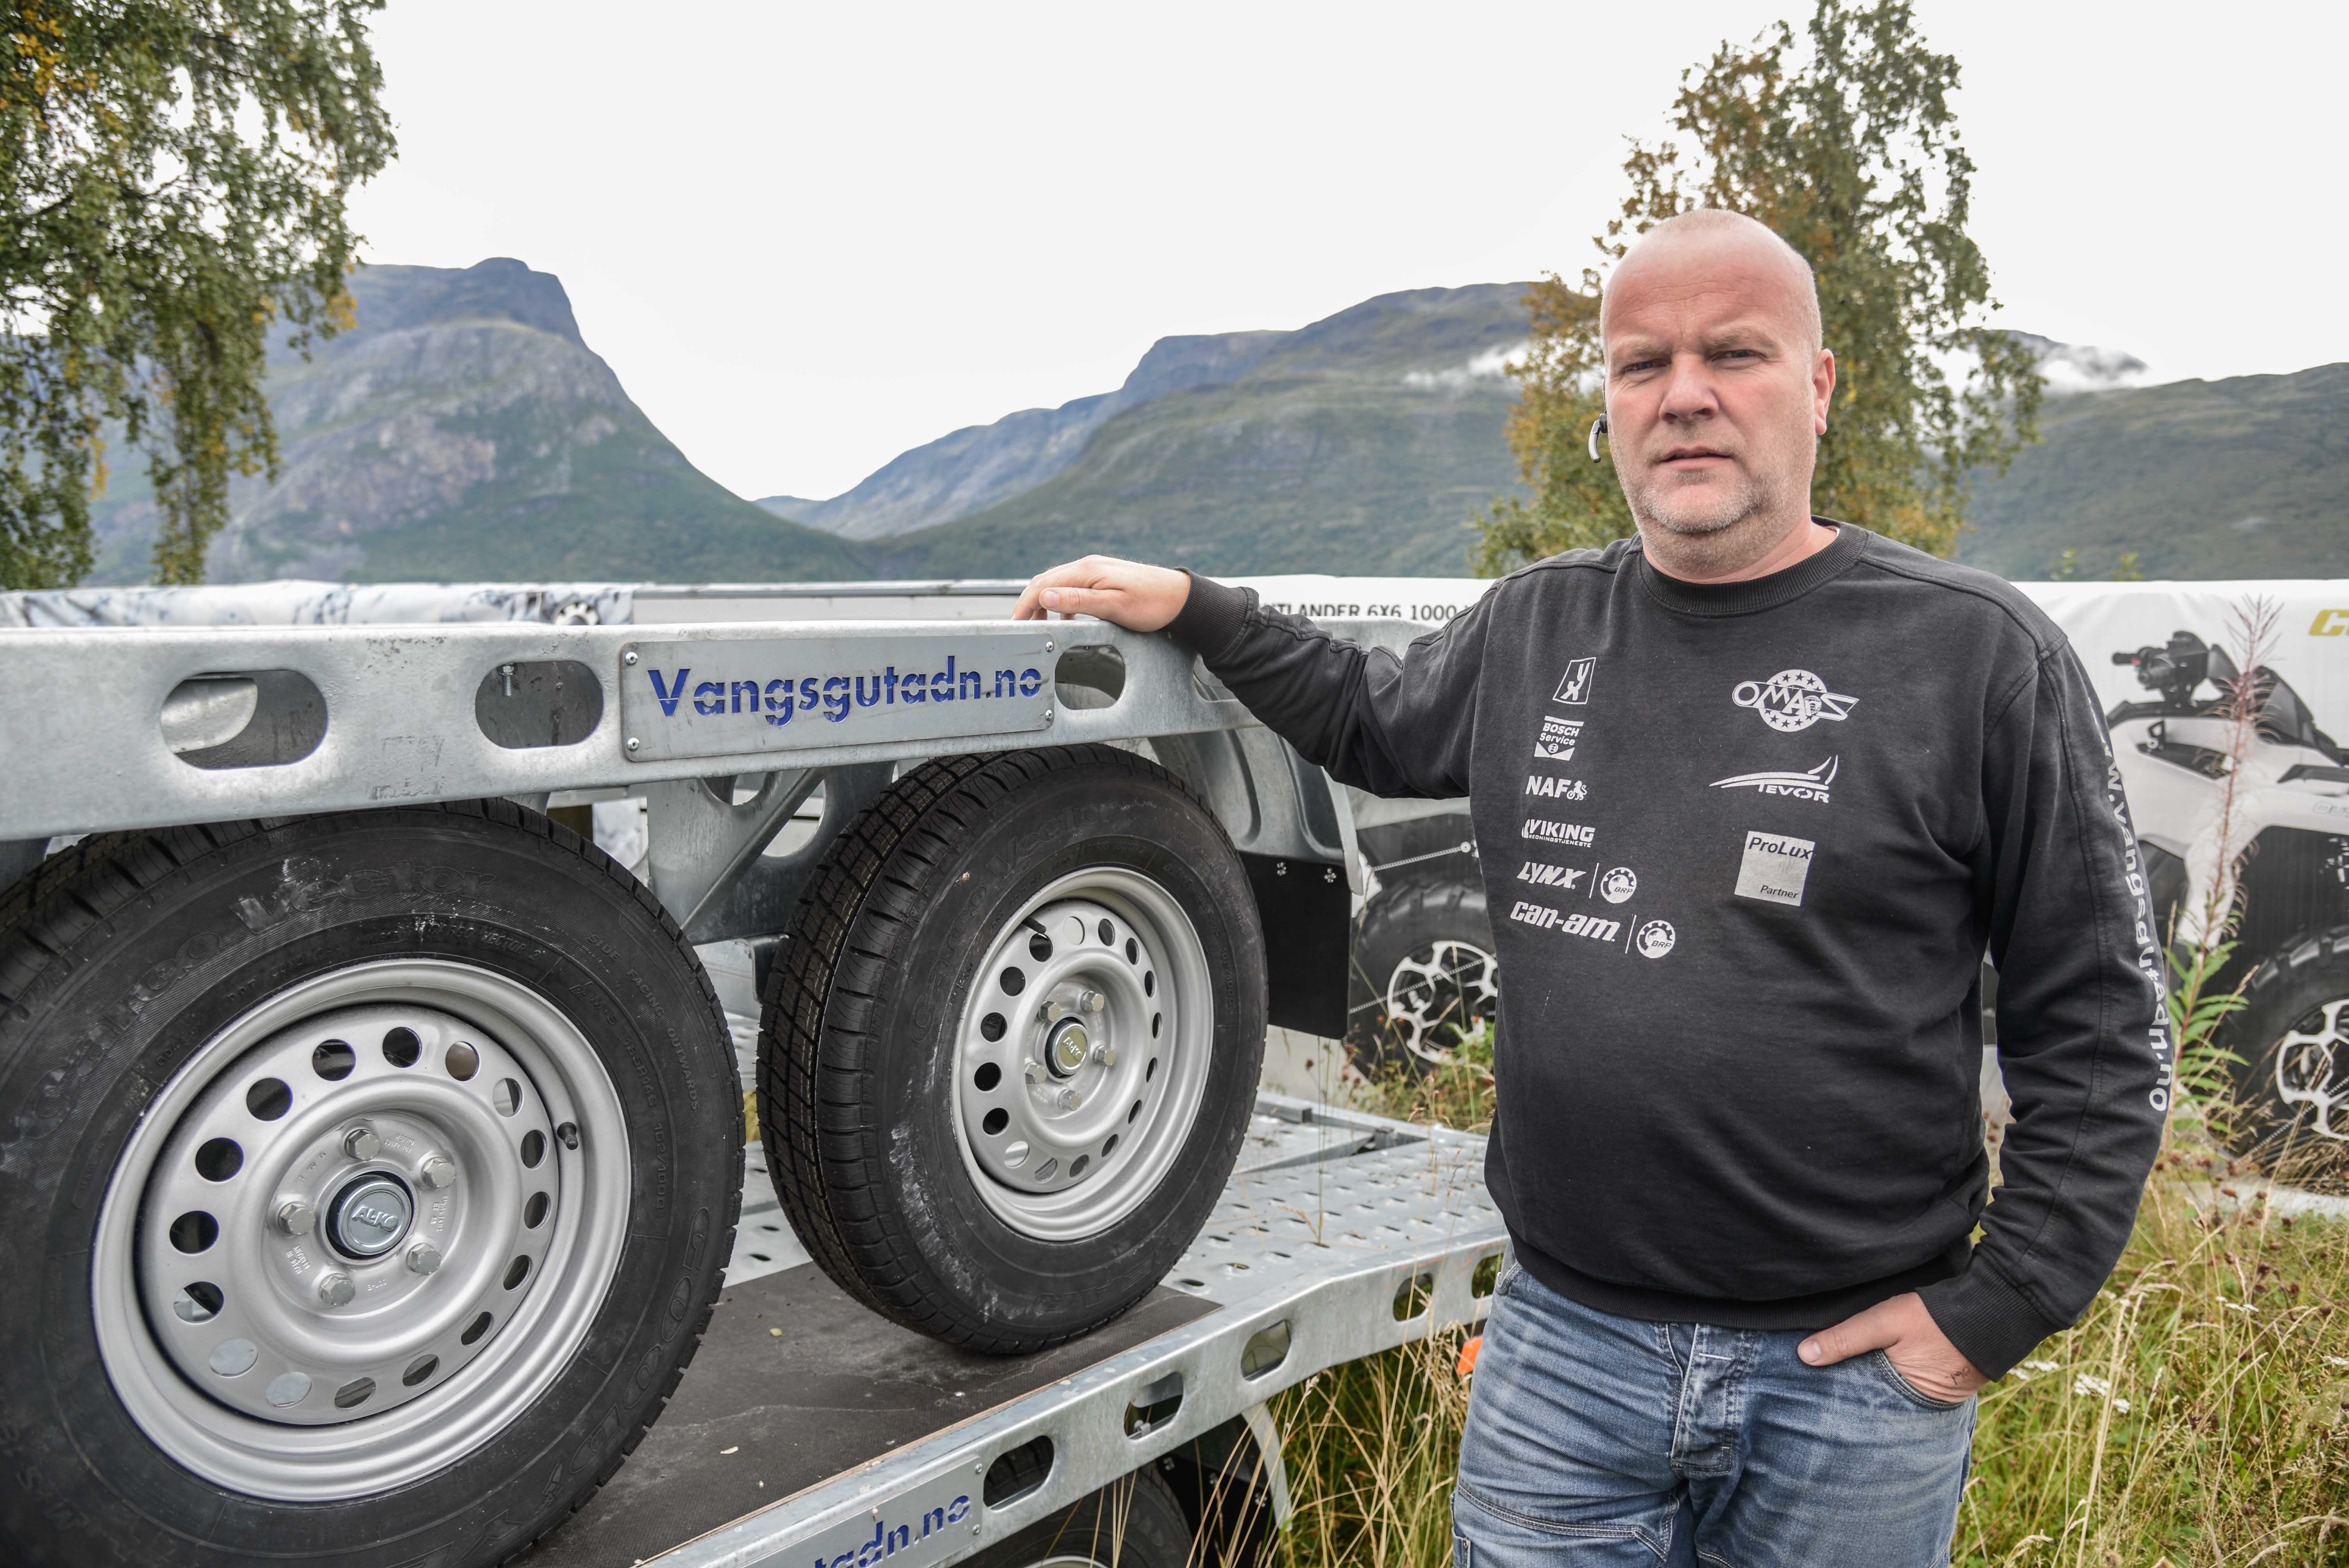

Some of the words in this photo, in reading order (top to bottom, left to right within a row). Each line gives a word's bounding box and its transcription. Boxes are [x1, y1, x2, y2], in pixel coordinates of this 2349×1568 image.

[1411, 604, 1457, 620] 1000
[648, 655, 1042, 727] Vangsgutadn.no
[1542, 722, 1581, 737] BOSCH
[1539, 732, 1576, 747] Service
[1525, 775, 1572, 799] NAF
[1758, 783, 1830, 803] TEVOR
[1527, 819, 1595, 842] VIKING
[1528, 834, 1592, 848] REDNINGSTJENESTE
[1748, 836, 1813, 860] ProLux
[1516, 861, 1586, 889] LYNX
[1614, 886, 1634, 895] BRP
[1760, 885, 1799, 899] Partner
[1651, 940, 1672, 950] BRP
[586, 934, 621, 963] SIDE
[626, 967, 665, 1017] FACING
[667, 1026, 702, 1112] OUTWARDS
